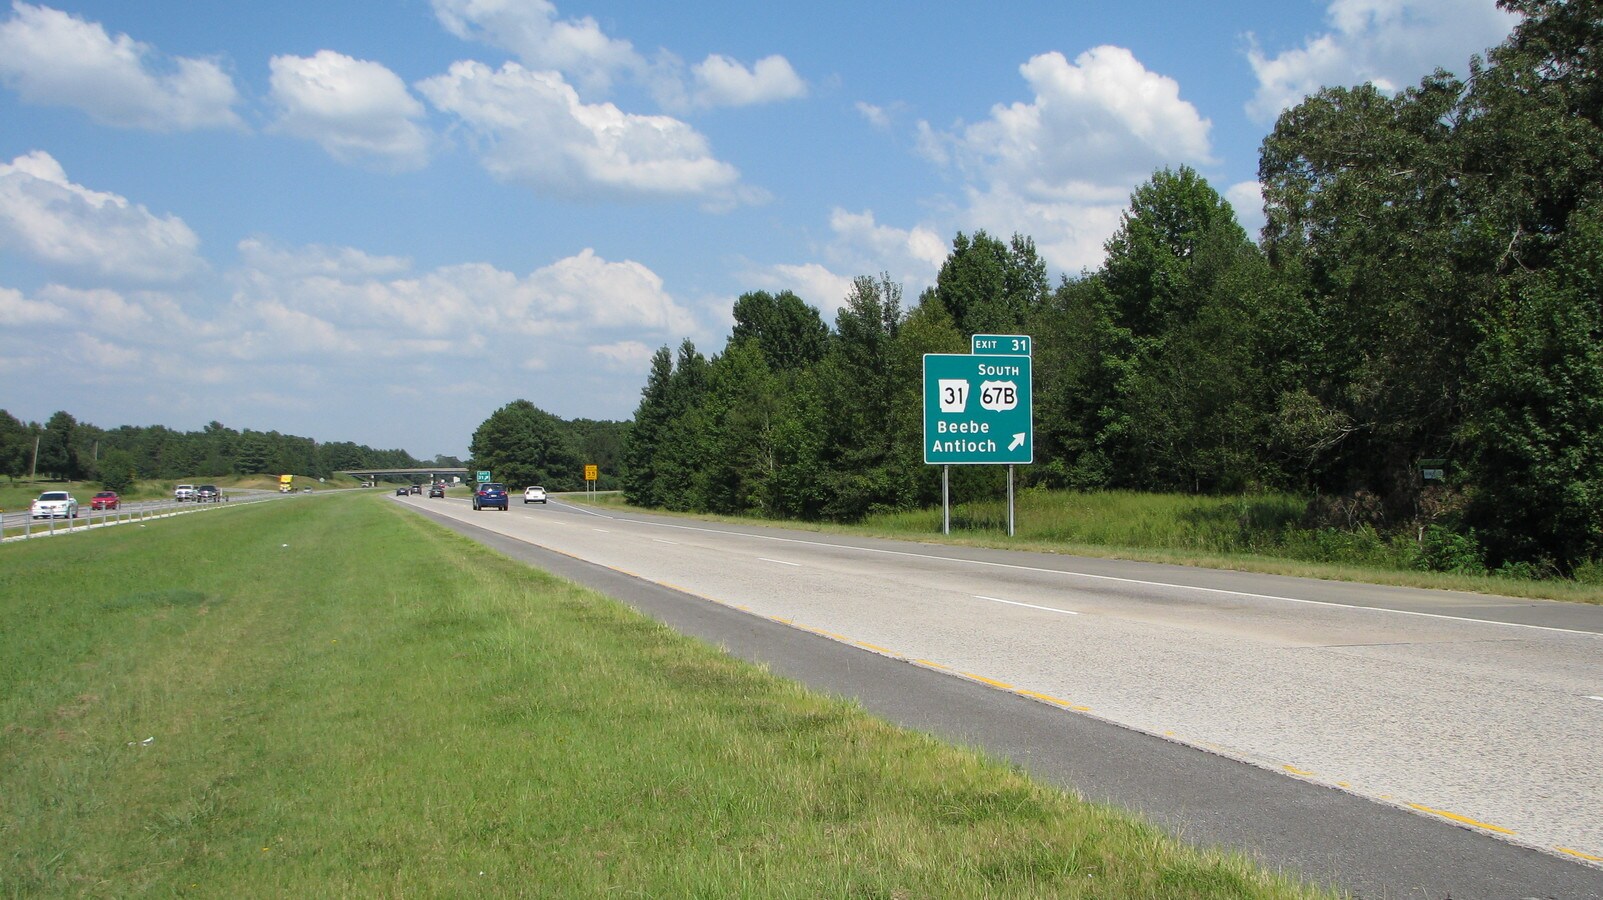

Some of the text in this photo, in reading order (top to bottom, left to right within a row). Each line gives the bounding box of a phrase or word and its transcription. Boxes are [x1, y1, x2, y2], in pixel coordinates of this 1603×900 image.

[975, 340, 1026, 351] EXIT 31
[978, 364, 1019, 376] SOUTH
[945, 387, 963, 404] 31
[982, 387, 1015, 404] 67B
[937, 420, 989, 433] Beebe
[932, 439, 996, 452] Antioch
